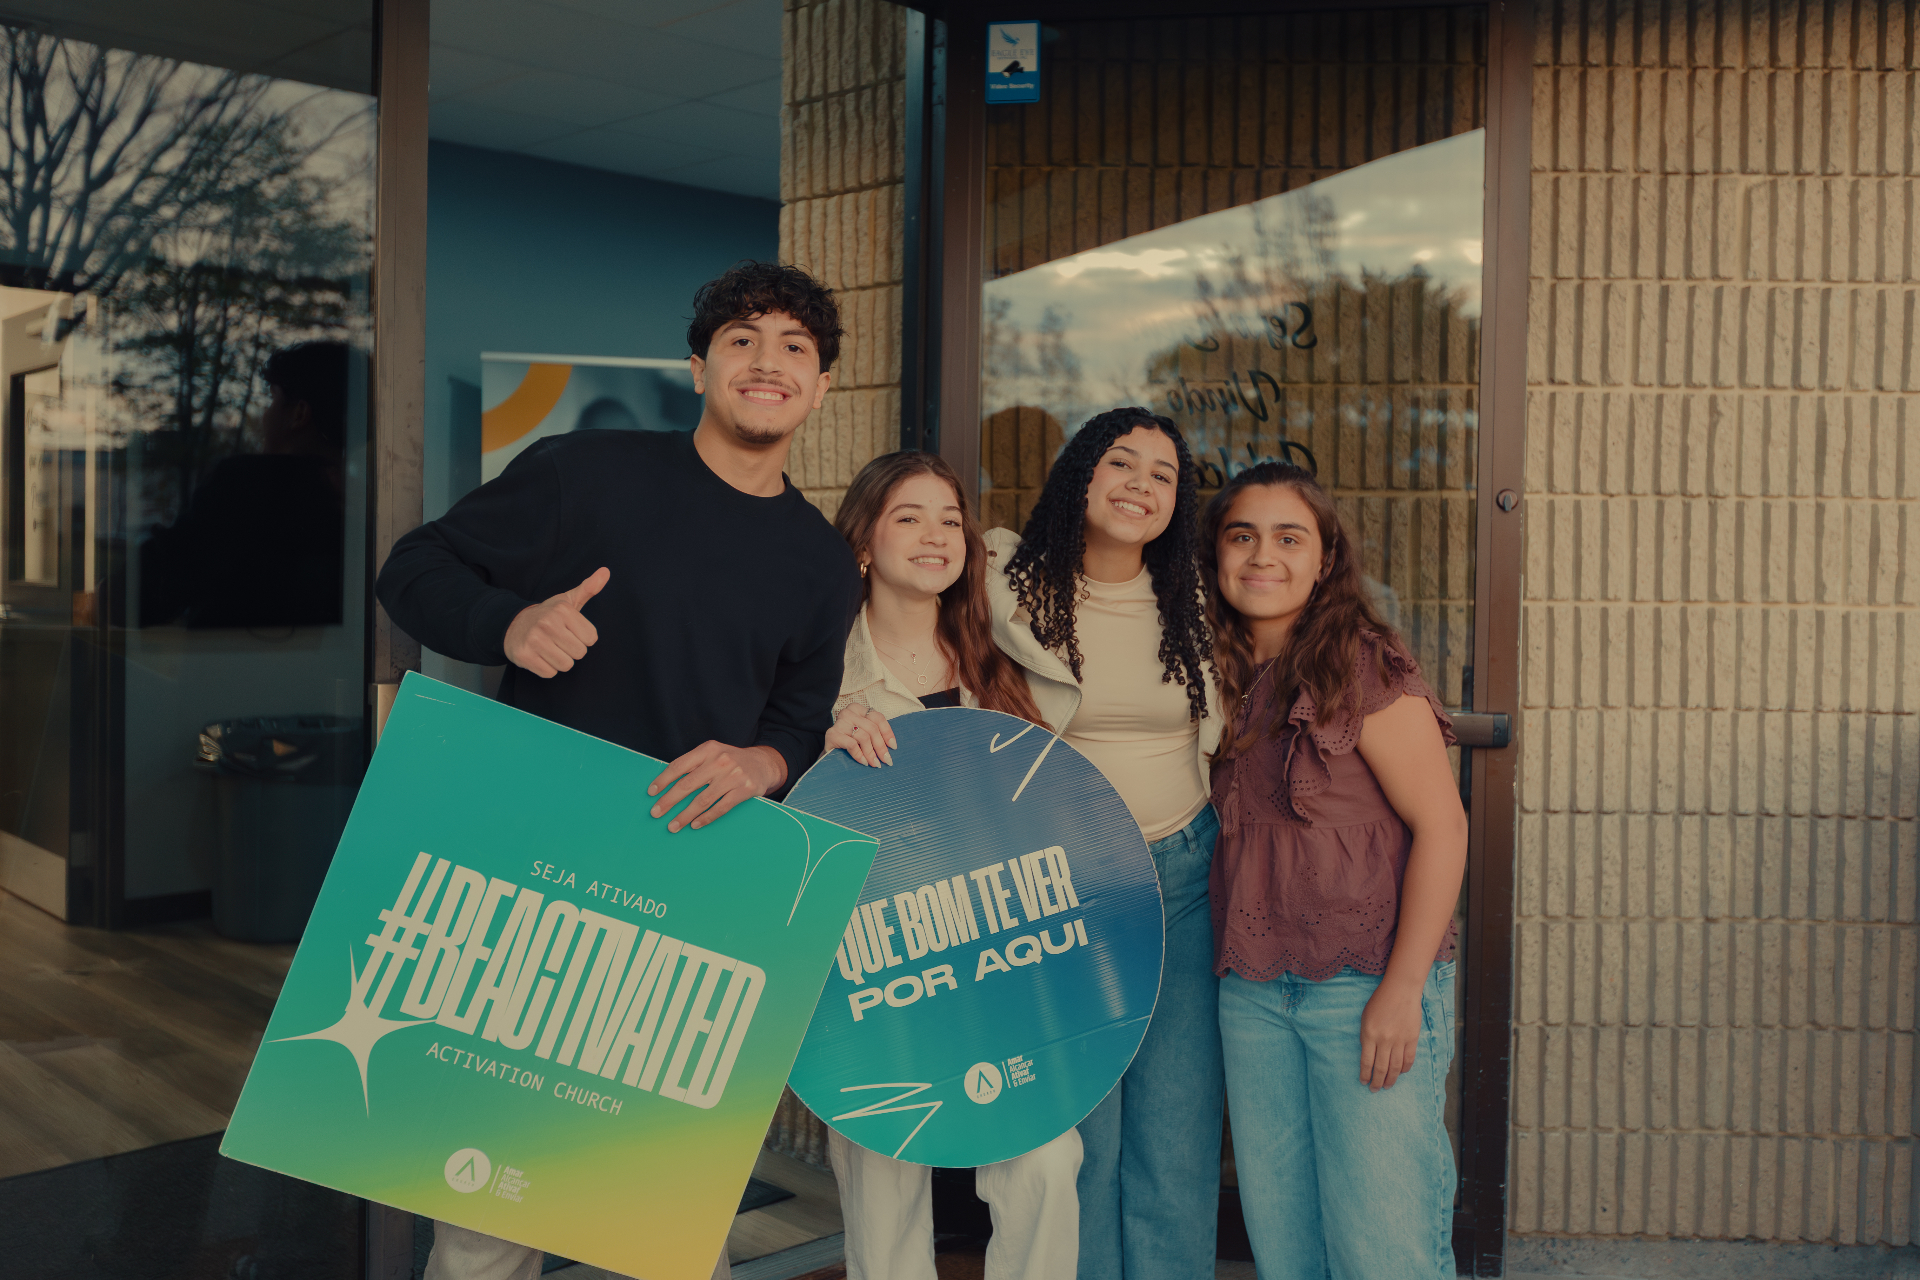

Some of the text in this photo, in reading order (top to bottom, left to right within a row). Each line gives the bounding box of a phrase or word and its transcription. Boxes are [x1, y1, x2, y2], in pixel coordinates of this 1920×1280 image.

[529, 859, 668, 919] SEJA ATIVADO
[836, 845, 1080, 986] QUE BOM TE VER
[345, 851, 767, 1110] #BEACTIVATED
[847, 918, 1089, 1022] POR AQUI
[426, 1041, 623, 1116] ACTIVATION CHURCH
[498, 1181, 521, 1194] Ativar
[502, 1191, 523, 1203] Enviar
[504, 1166, 524, 1177] Amar
